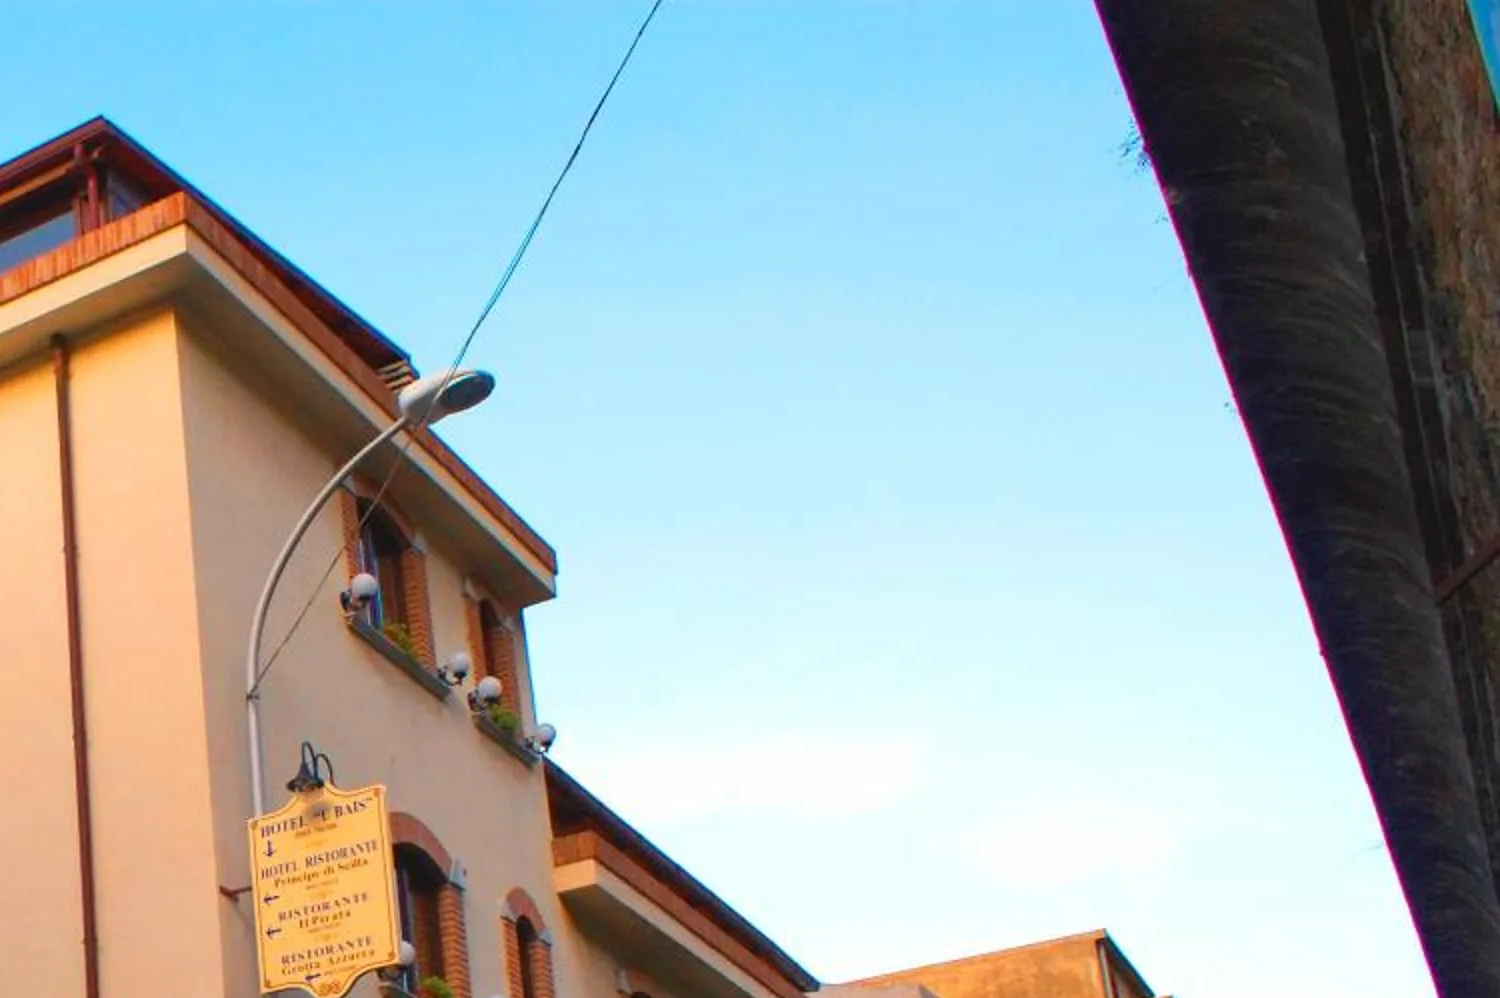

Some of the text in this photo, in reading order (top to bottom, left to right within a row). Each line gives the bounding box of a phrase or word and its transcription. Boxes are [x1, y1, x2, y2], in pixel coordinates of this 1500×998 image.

[261, 815, 307, 838] HOTEL
[261, 839, 377, 880] HOTEL RISTORANTE
[278, 892, 368, 921] RISTORANTE
[281, 935, 372, 965] RISTORANTE
